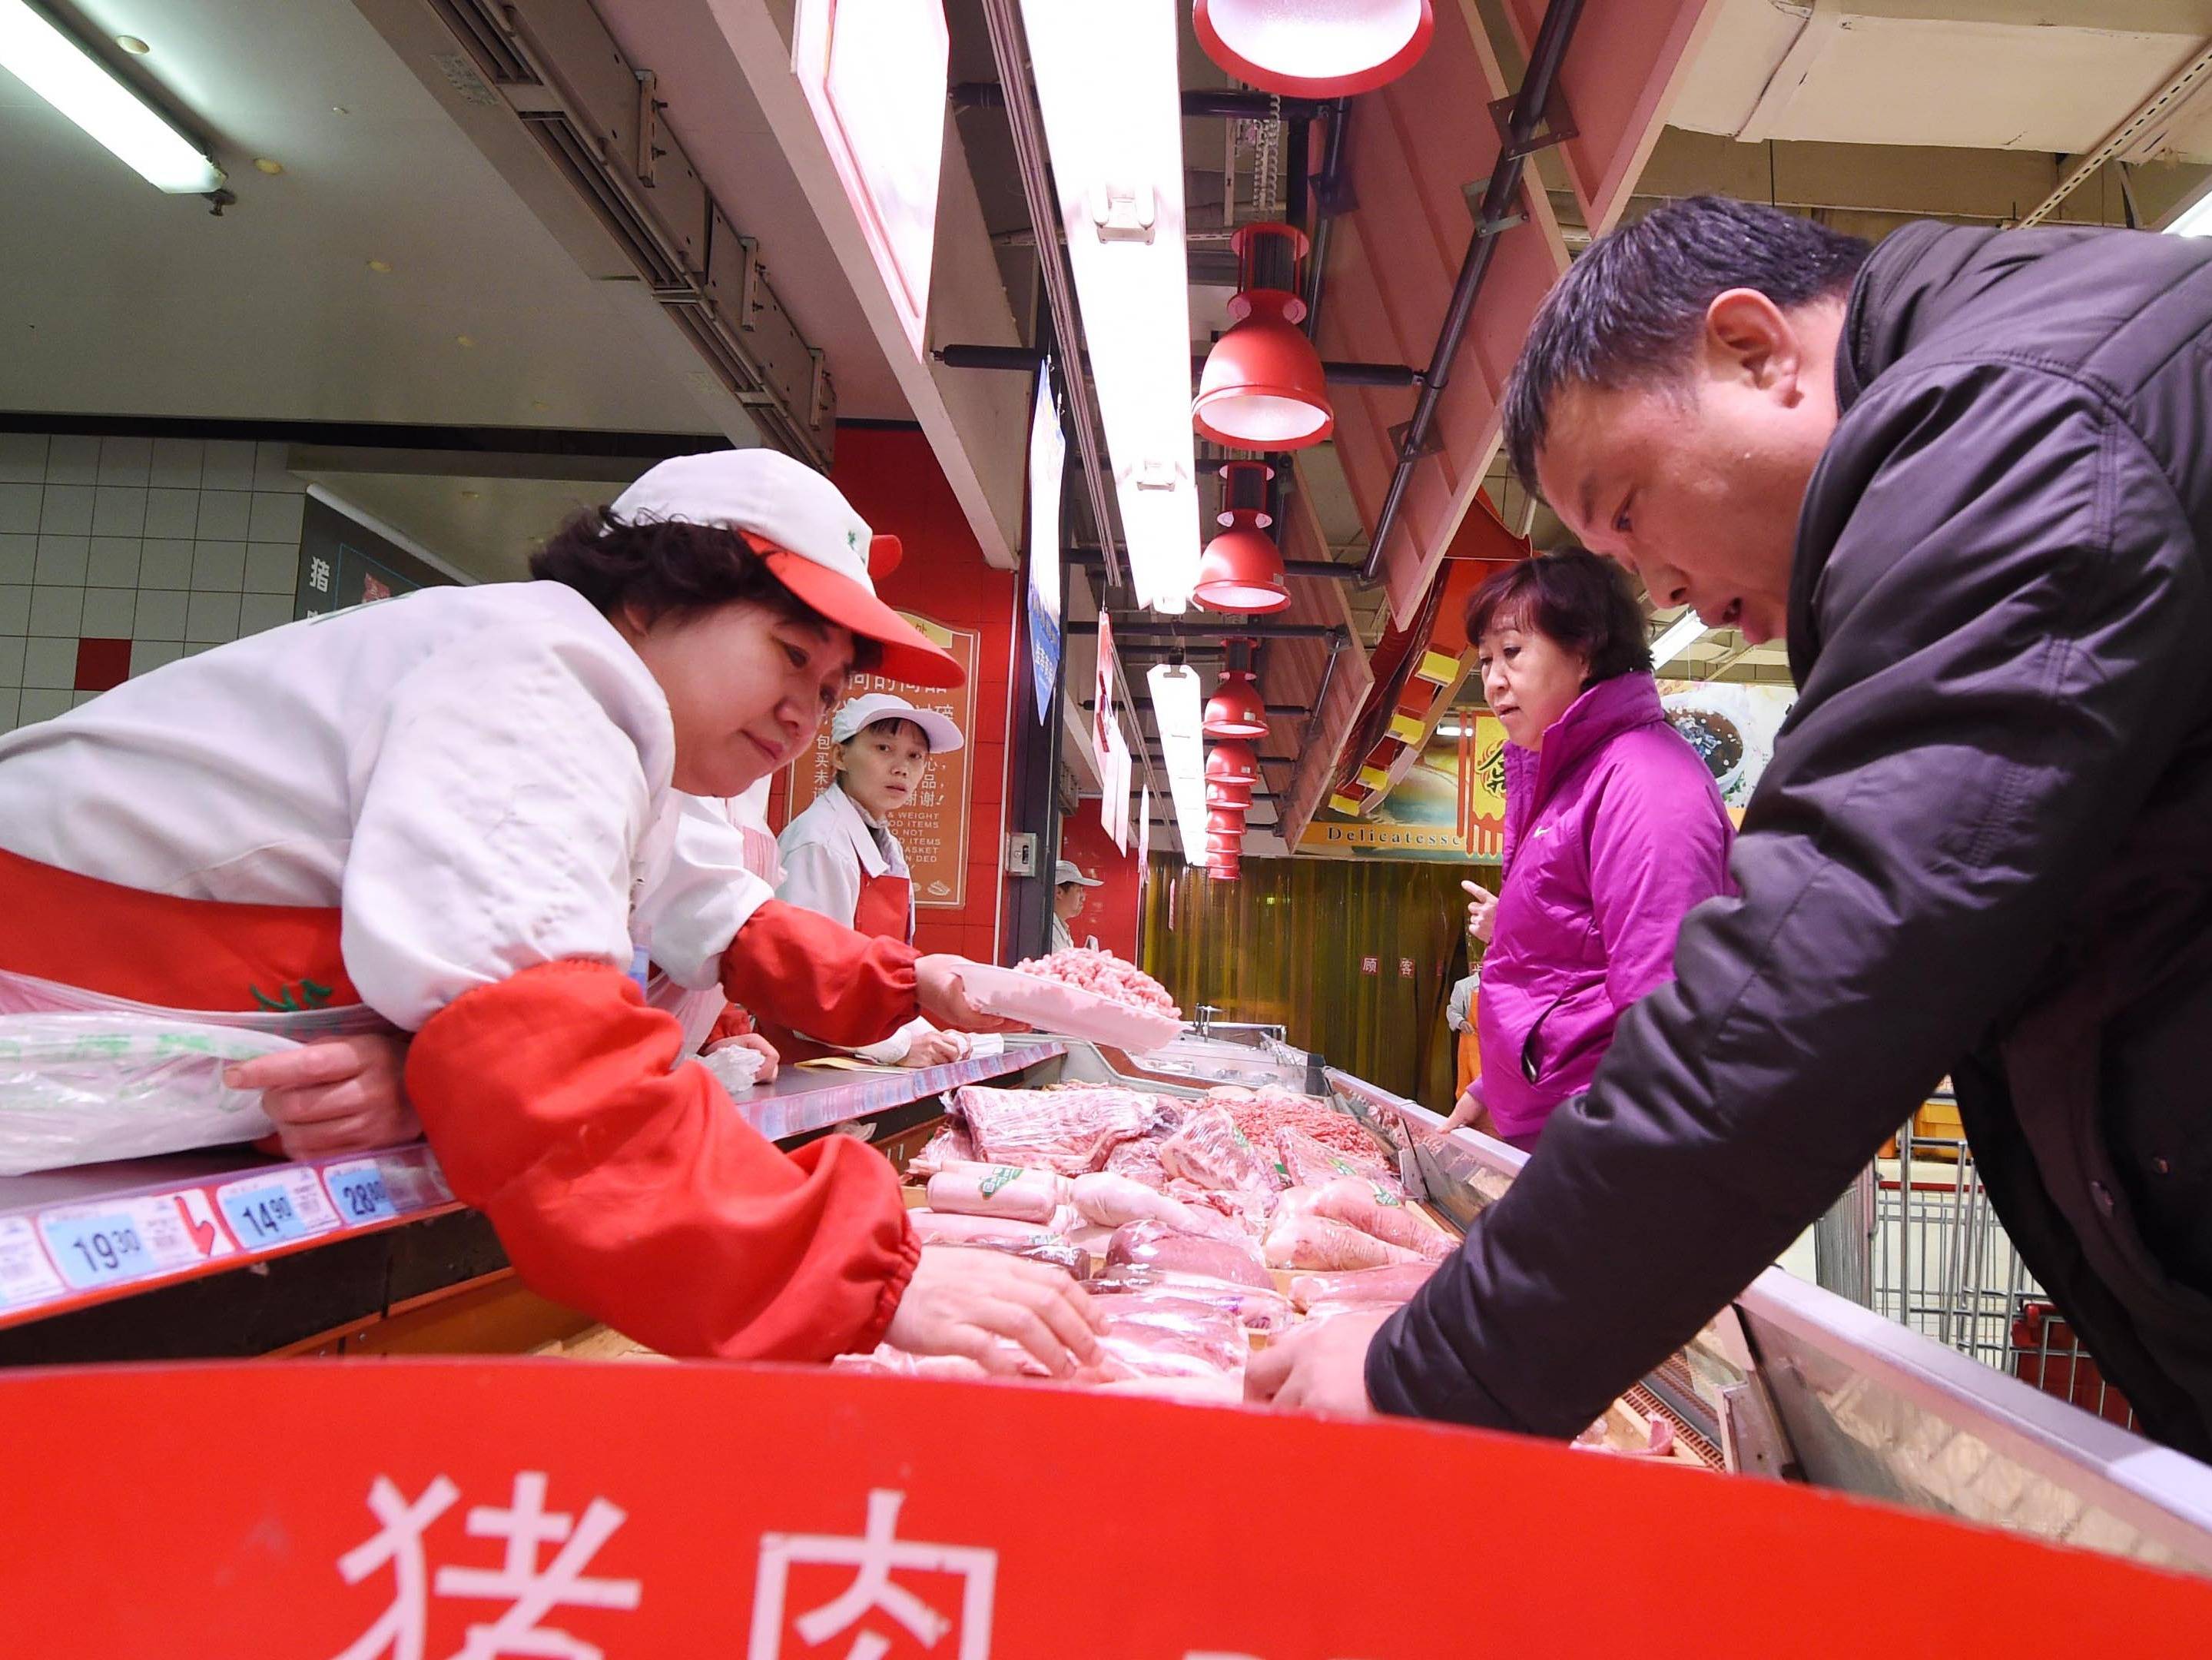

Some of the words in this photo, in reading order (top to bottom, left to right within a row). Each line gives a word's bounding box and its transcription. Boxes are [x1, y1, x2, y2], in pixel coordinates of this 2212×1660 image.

[816, 734, 831, 750] 包
[898, 812, 940, 820] WEIGHT
[330, 1471, 998, 1660] 猪肉
